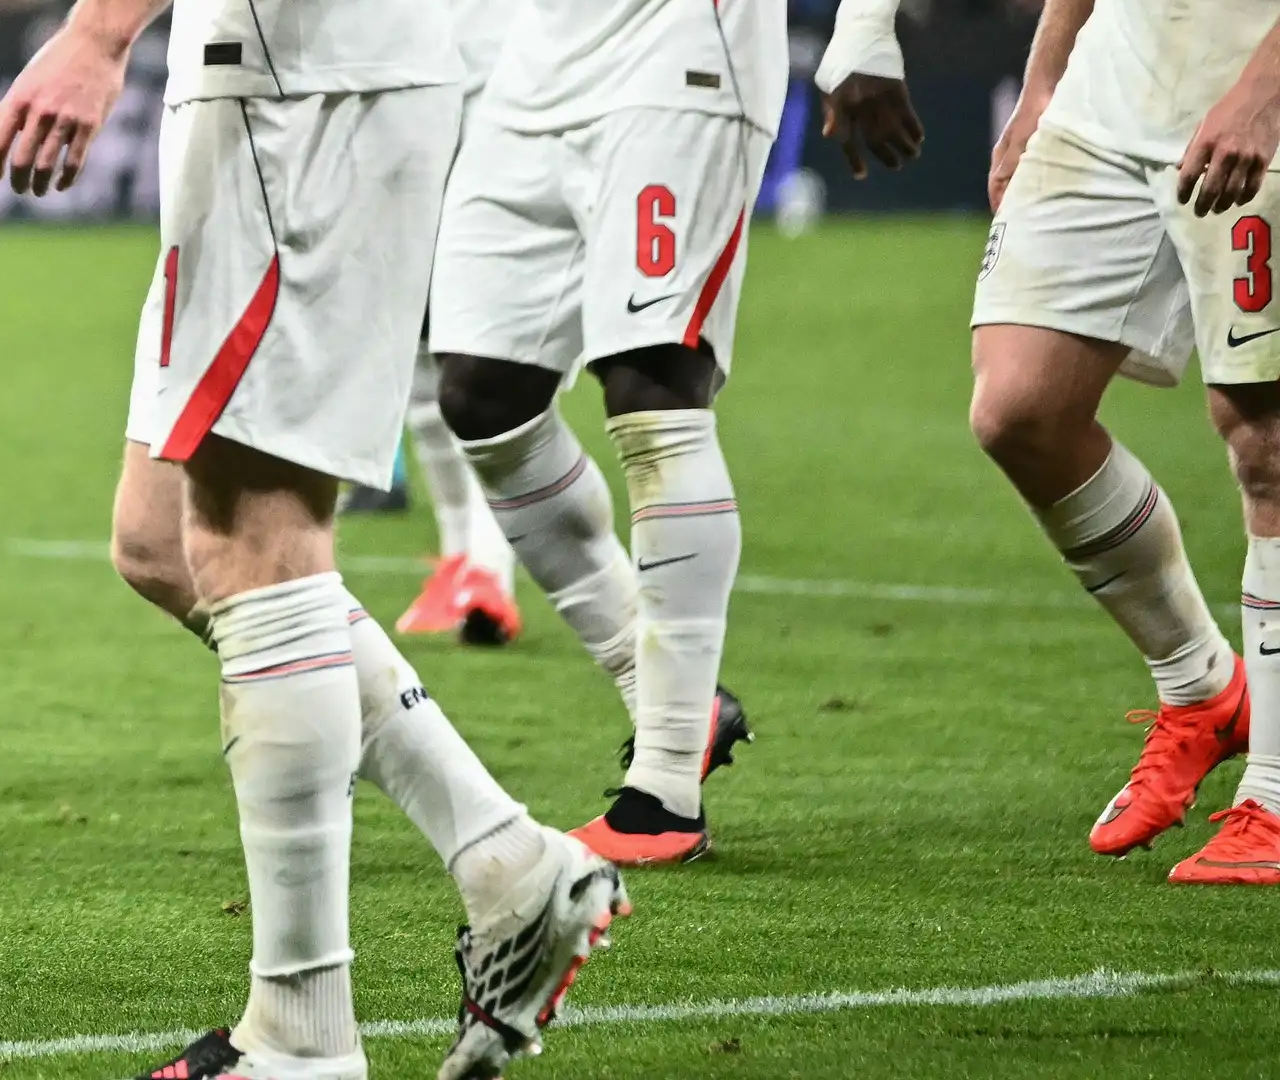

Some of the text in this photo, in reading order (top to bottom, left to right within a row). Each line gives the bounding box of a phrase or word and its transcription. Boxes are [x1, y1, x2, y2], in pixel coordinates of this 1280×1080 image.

[635, 183, 677, 279] 6
[1230, 214, 1273, 314] 3
[400, 686, 428, 710] EN
